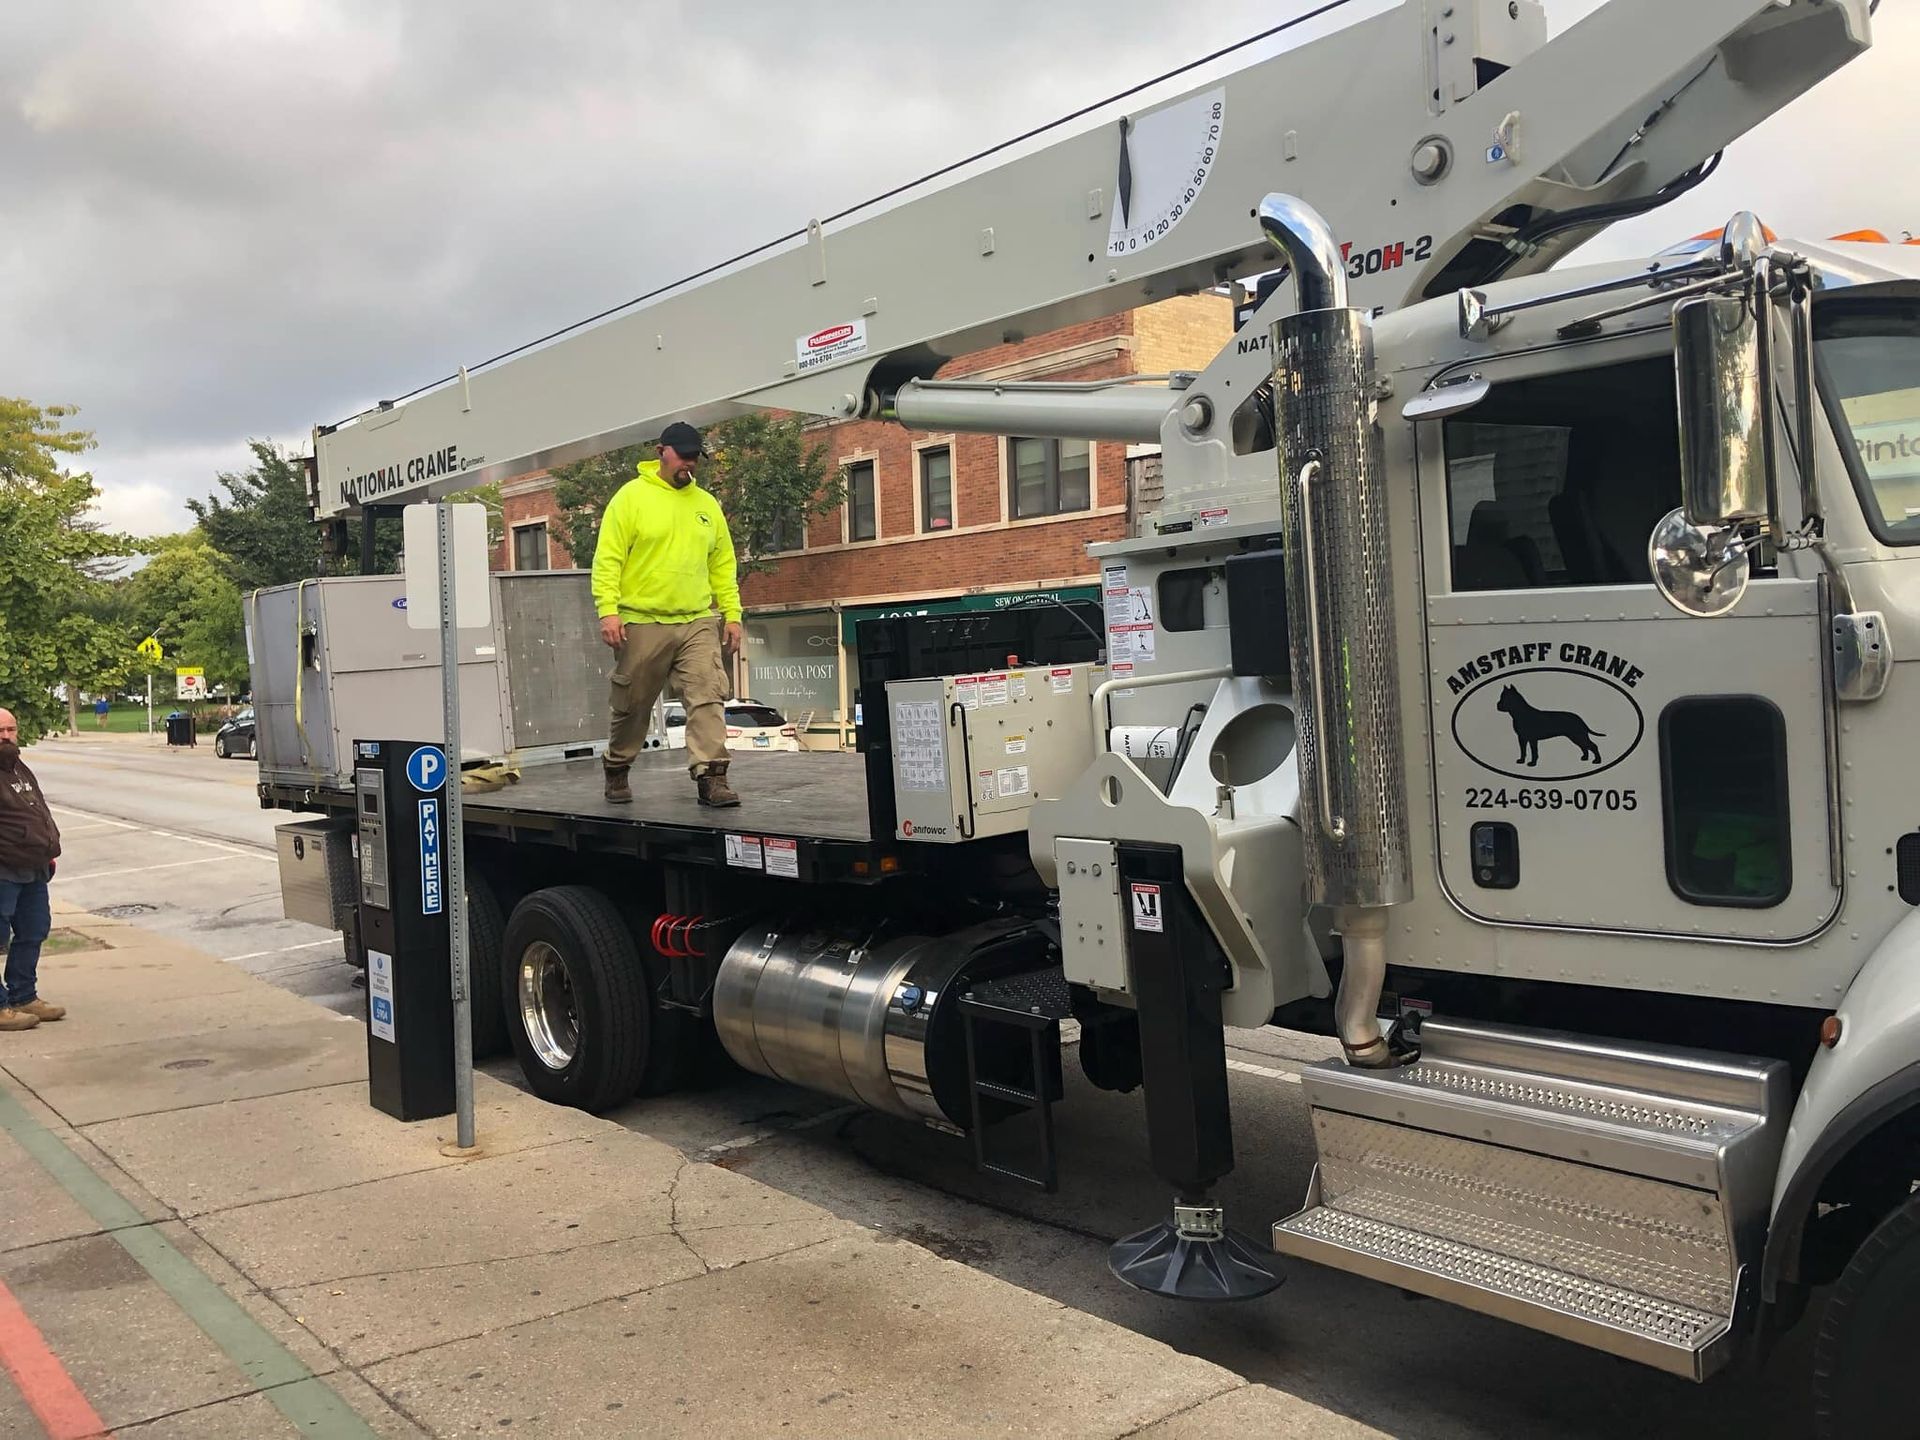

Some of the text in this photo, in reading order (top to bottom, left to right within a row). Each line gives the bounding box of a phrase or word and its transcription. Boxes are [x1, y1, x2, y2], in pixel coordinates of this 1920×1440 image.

[1109, 102, 1222, 253] -10 0 10 20 30 40 50 60 70 80
[1238, 335, 1271, 355] NAT
[340, 445, 457, 504] NATIONAL CRANE
[994, 596, 1011, 608] SEW
[1011, 595, 1024, 606] ON
[752, 664, 834, 680] THE YOGA POST
[1446, 642, 1645, 695] AMSTAFF CRANE
[421, 754, 439, 784] P
[1465, 788, 1638, 810] 224-639-0705
[423, 804, 439, 908] PAY HERE
